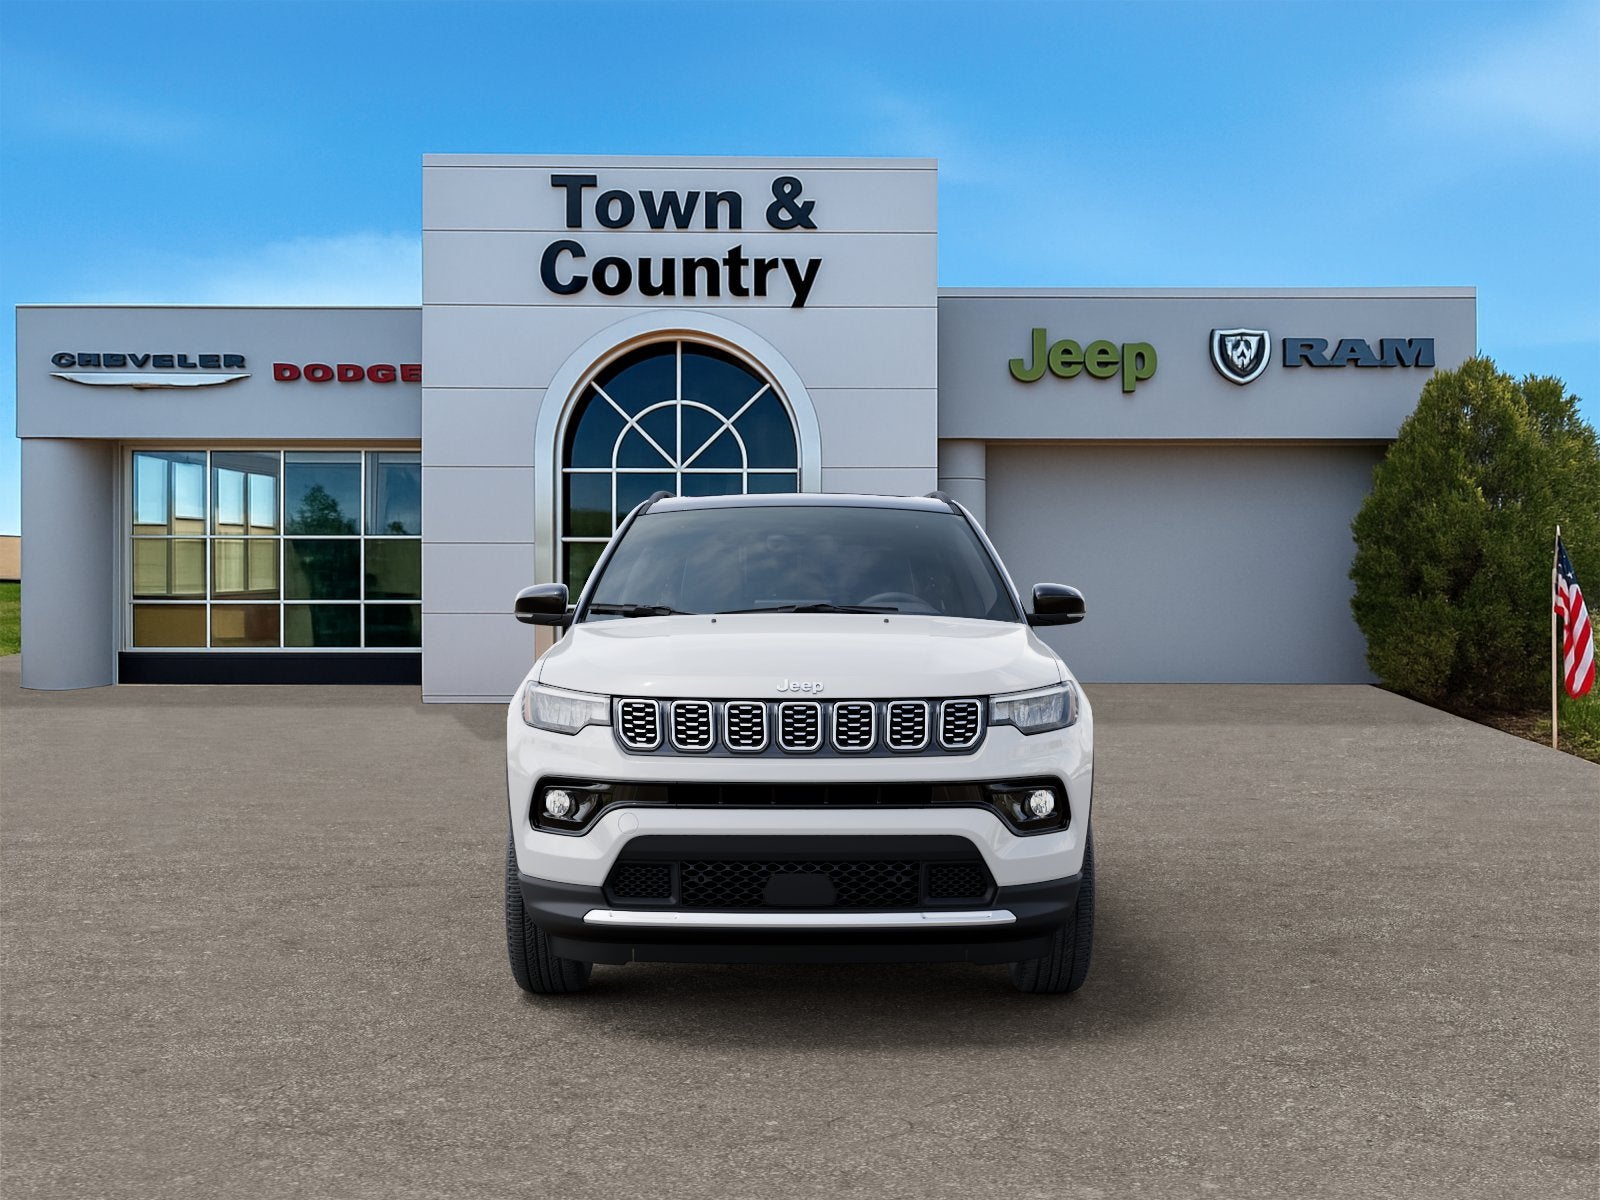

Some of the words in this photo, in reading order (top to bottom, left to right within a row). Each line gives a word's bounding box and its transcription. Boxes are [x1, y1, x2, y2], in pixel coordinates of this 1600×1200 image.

[551, 174, 742, 229] Town
[765, 175, 818, 230] &
[540, 239, 823, 308] Country
[272, 362, 423, 384] DODGE
[1008, 328, 1158, 393] Jeep
[1282, 337, 1435, 368] RAM
[776, 678, 825, 695] Jeep
